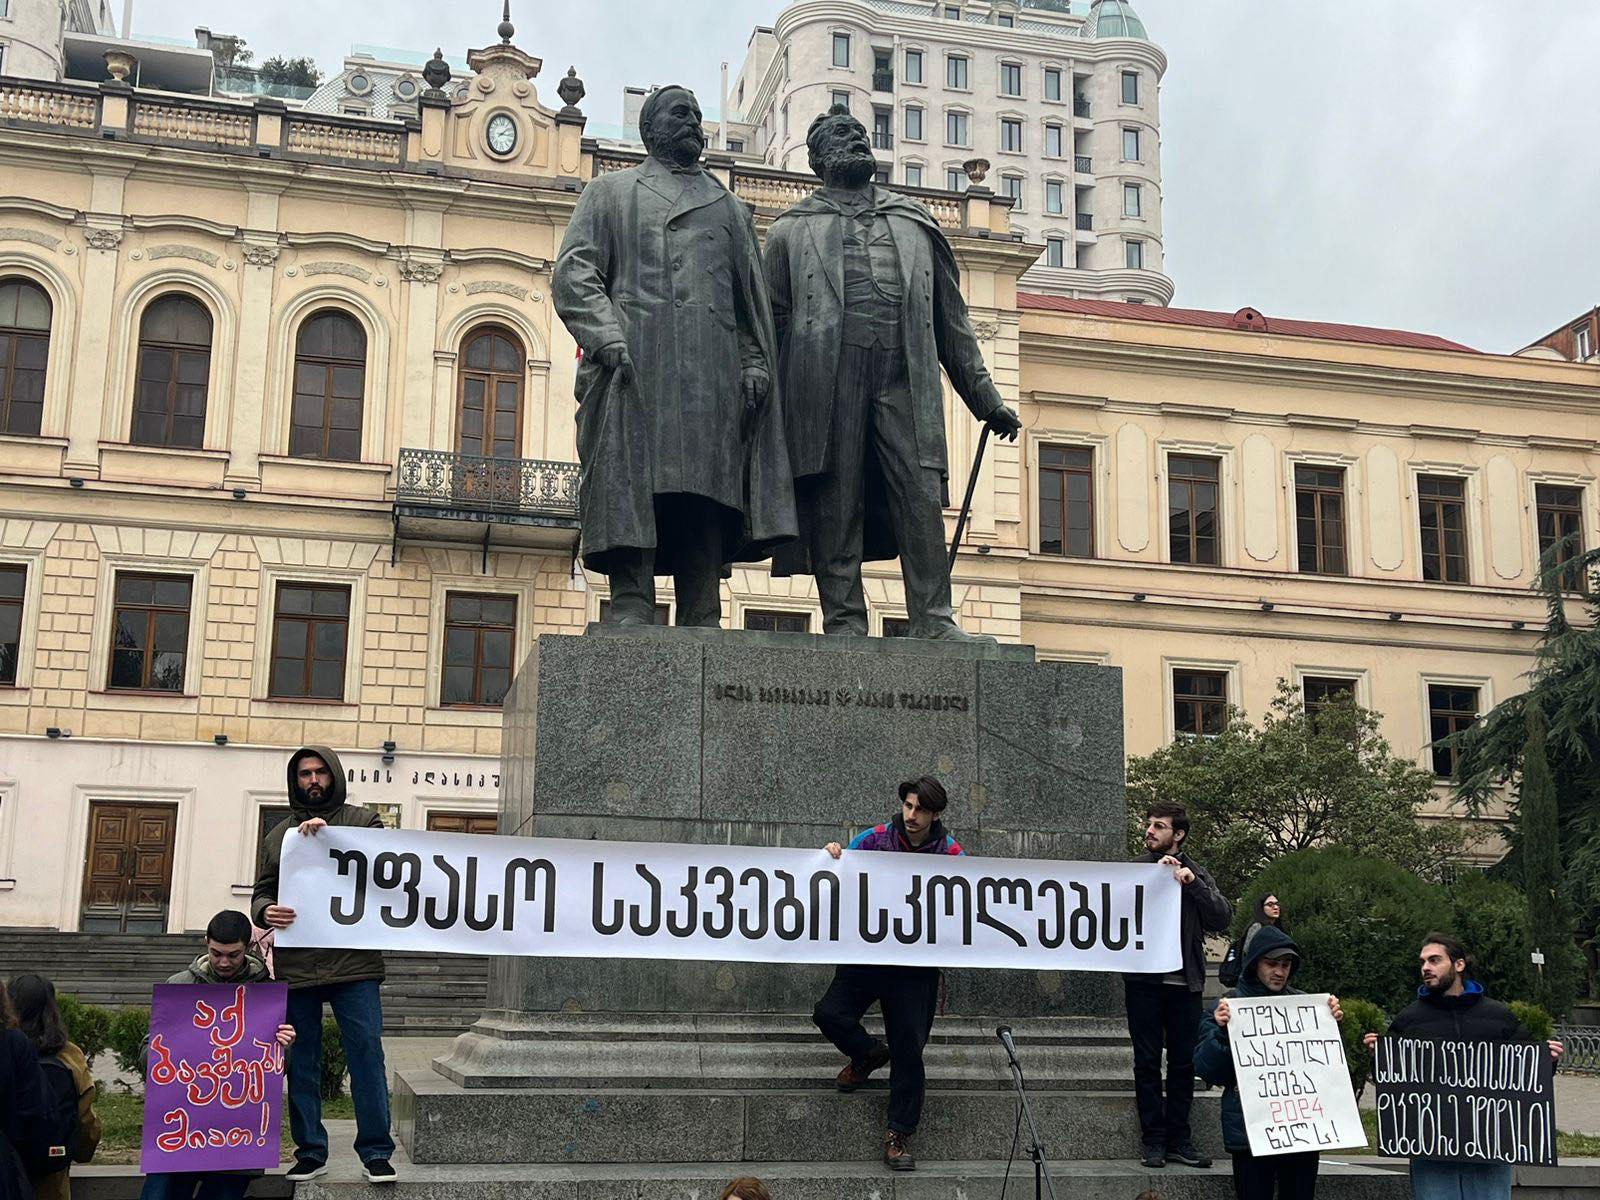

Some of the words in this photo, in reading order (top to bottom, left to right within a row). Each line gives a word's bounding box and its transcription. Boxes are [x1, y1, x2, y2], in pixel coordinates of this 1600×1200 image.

[412, 771, 500, 788] კლასიკუ
[329, 848, 556, 933] უფასო
[593, 861, 840, 941] საკვები
[858, 872, 1144, 951] სკოლებს!
[193, 985, 246, 1047] აქ
[1238, 1005, 1319, 1038] უფასო
[151, 1034, 285, 1109] ბავშვებს
[1234, 1039, 1344, 1067] სასკოლო
[1374, 1036, 1435, 1084] სასკოლო
[1439, 1040, 1543, 1094] კვებისთვის
[1258, 1070, 1318, 1098] კვება
[156, 1102, 270, 1152] შიათ!
[1269, 1097, 1325, 1124] 2024
[1377, 1092, 1460, 1156] დაბეგრე
[1465, 1094, 1553, 1165] მდიდარი!
[1265, 1120, 1341, 1149] წელს!
